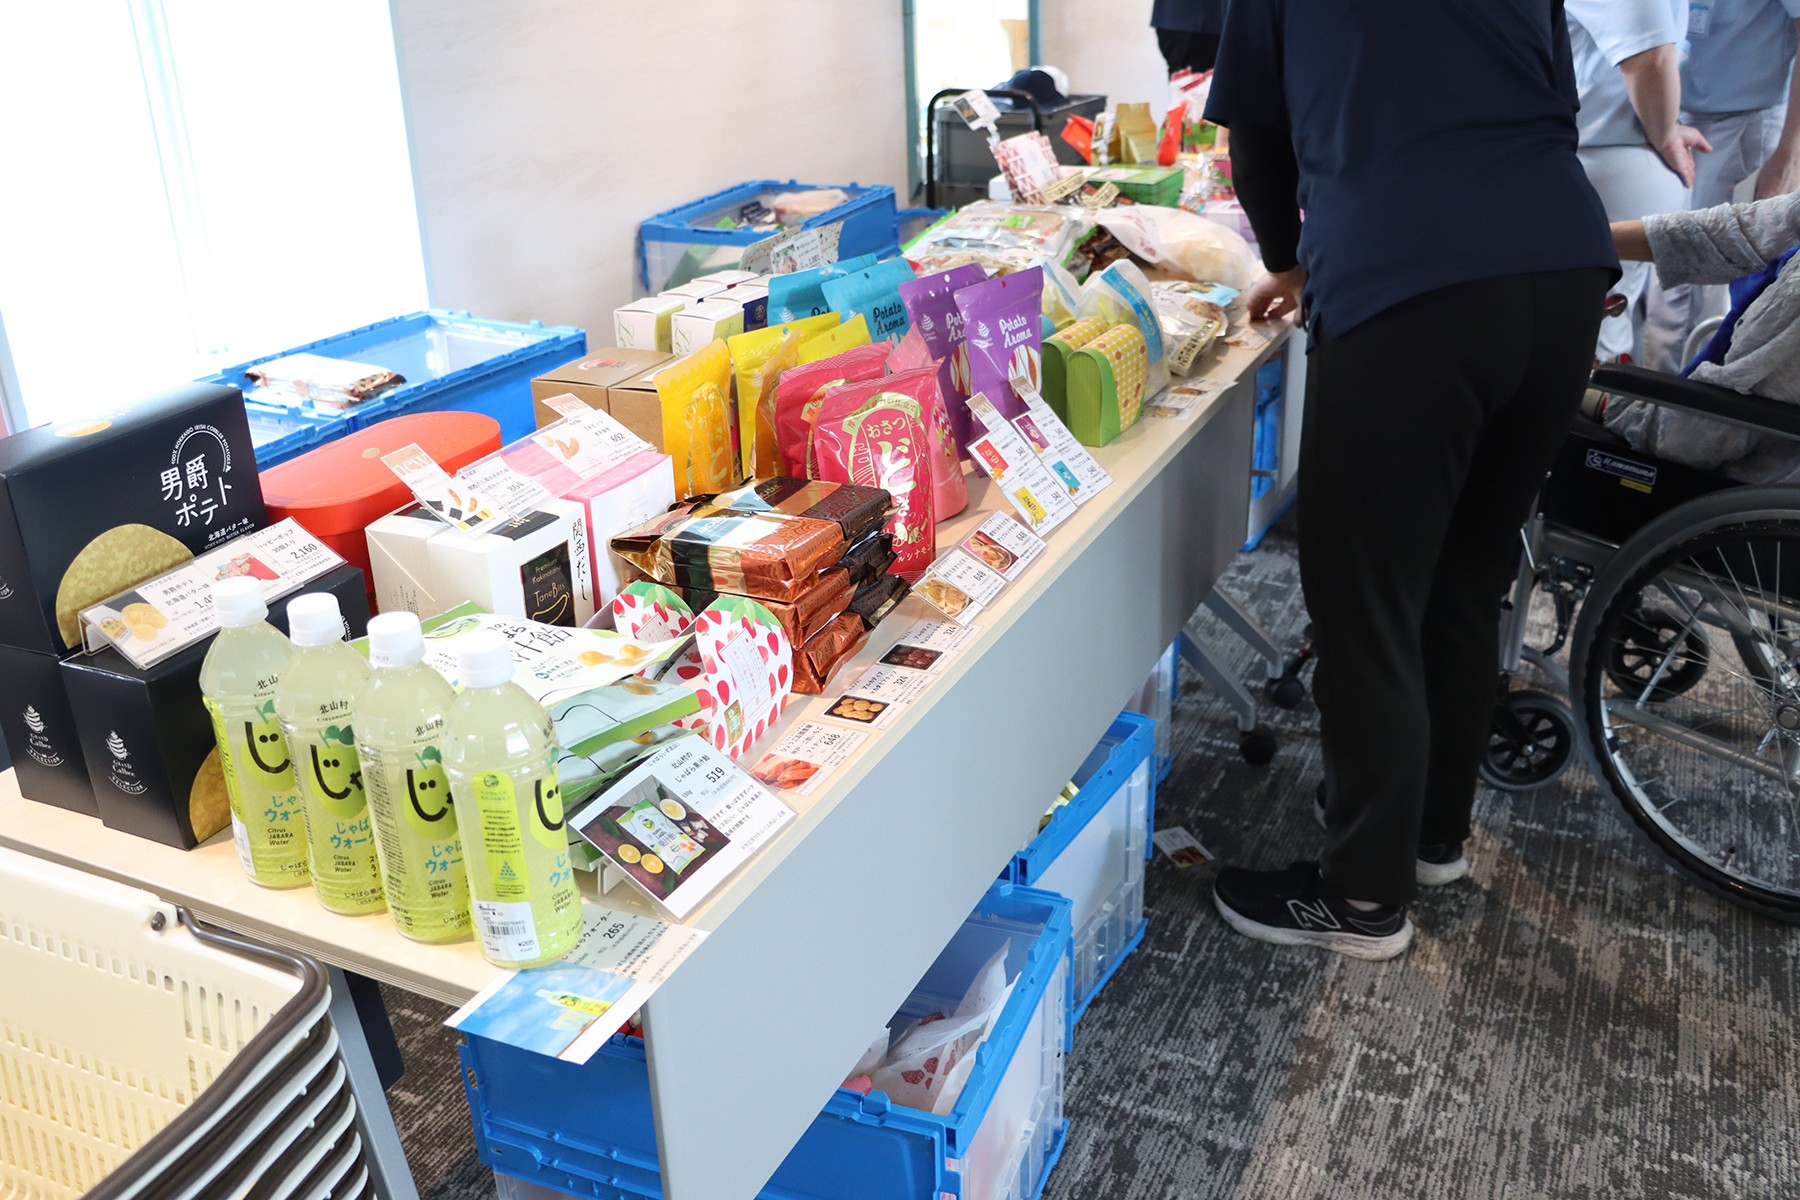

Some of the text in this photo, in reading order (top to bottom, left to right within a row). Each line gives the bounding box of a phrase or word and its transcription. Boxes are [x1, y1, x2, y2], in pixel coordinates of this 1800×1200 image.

[872, 302, 902, 322] Potato
[876, 316, 905, 336] Aroma
[999, 315, 1028, 335] Potato
[1004, 328, 1033, 349] Aroma
[867, 417, 907, 438] おさつ
[175, 426, 194, 449] HOKKAIDO
[207, 424, 224, 440] COBBLER
[610, 431, 626, 443] 692
[395, 454, 430, 476] new
[160, 453, 208, 501] 男爵
[175, 476, 233, 527] ポテト
[204, 538, 227, 550] HOKKAIDO
[240, 523, 255, 534] FLAVOR
[208, 517, 250, 542] 北海道バター味
[290, 542, 318, 560] 2,160
[534, 558, 558, 574] Premium
[973, 571, 987, 582] 648
[256, 674, 279, 690] 北山
[893, 675, 909, 686] 324
[320, 700, 348, 714] 北山村
[415, 718, 443, 736] 北山村
[29, 738, 52, 749] Calbee
[823, 733, 841, 746] 648
[29, 749, 60, 764] SELECTION
[671, 751, 693, 770] 北山村の
[112, 764, 136, 777] Calbee
[674, 754, 711, 783] じゃばら果汁飴
[706, 767, 726, 783] 519
[112, 776, 143, 792] SELECTION
[425, 858, 463, 875] ウォー
[430, 883, 453, 892] JABARA
[431, 890, 449, 899] Water
[552, 889, 569, 900] Citrus
[554, 901, 571, 913] Water
[603, 922, 625, 940] 265
